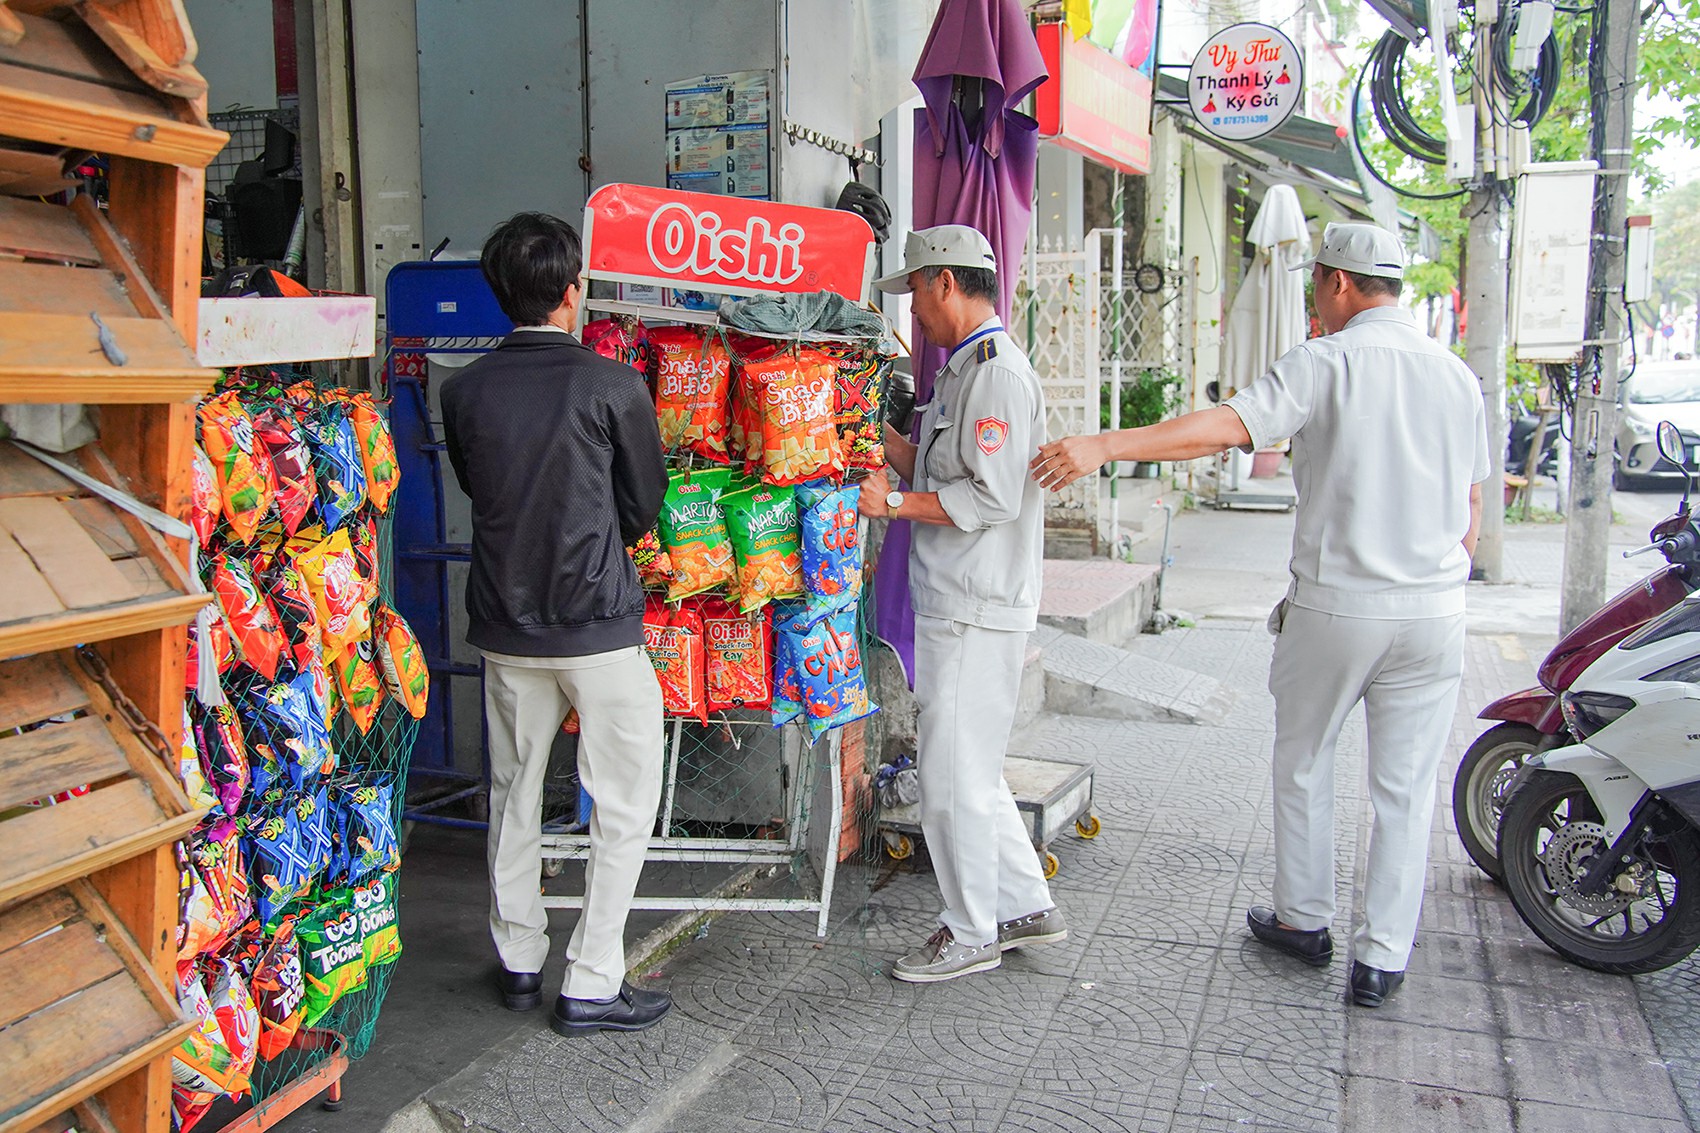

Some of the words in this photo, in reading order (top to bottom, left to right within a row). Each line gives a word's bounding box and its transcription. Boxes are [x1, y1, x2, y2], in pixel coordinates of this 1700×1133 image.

[1208, 44, 1238, 74] Vy
[1243, 38, 1282, 65] Thư
[1196, 73, 1249, 90] Thanh
[1254, 70, 1273, 90] Lý
[1226, 95, 1246, 111] Ký
[1250, 92, 1279, 108] Gửi
[646, 202, 805, 285] Oishi
[839, 359, 861, 370] Oishi
[758, 369, 787, 383] Oishi
[766, 376, 834, 405] Snack
[678, 484, 701, 494] Oishi
[752, 493, 773, 503] Oishi
[710, 622, 752, 641] Oishi
[714, 642, 735, 650] Snack
[723, 651, 743, 663] Cay
